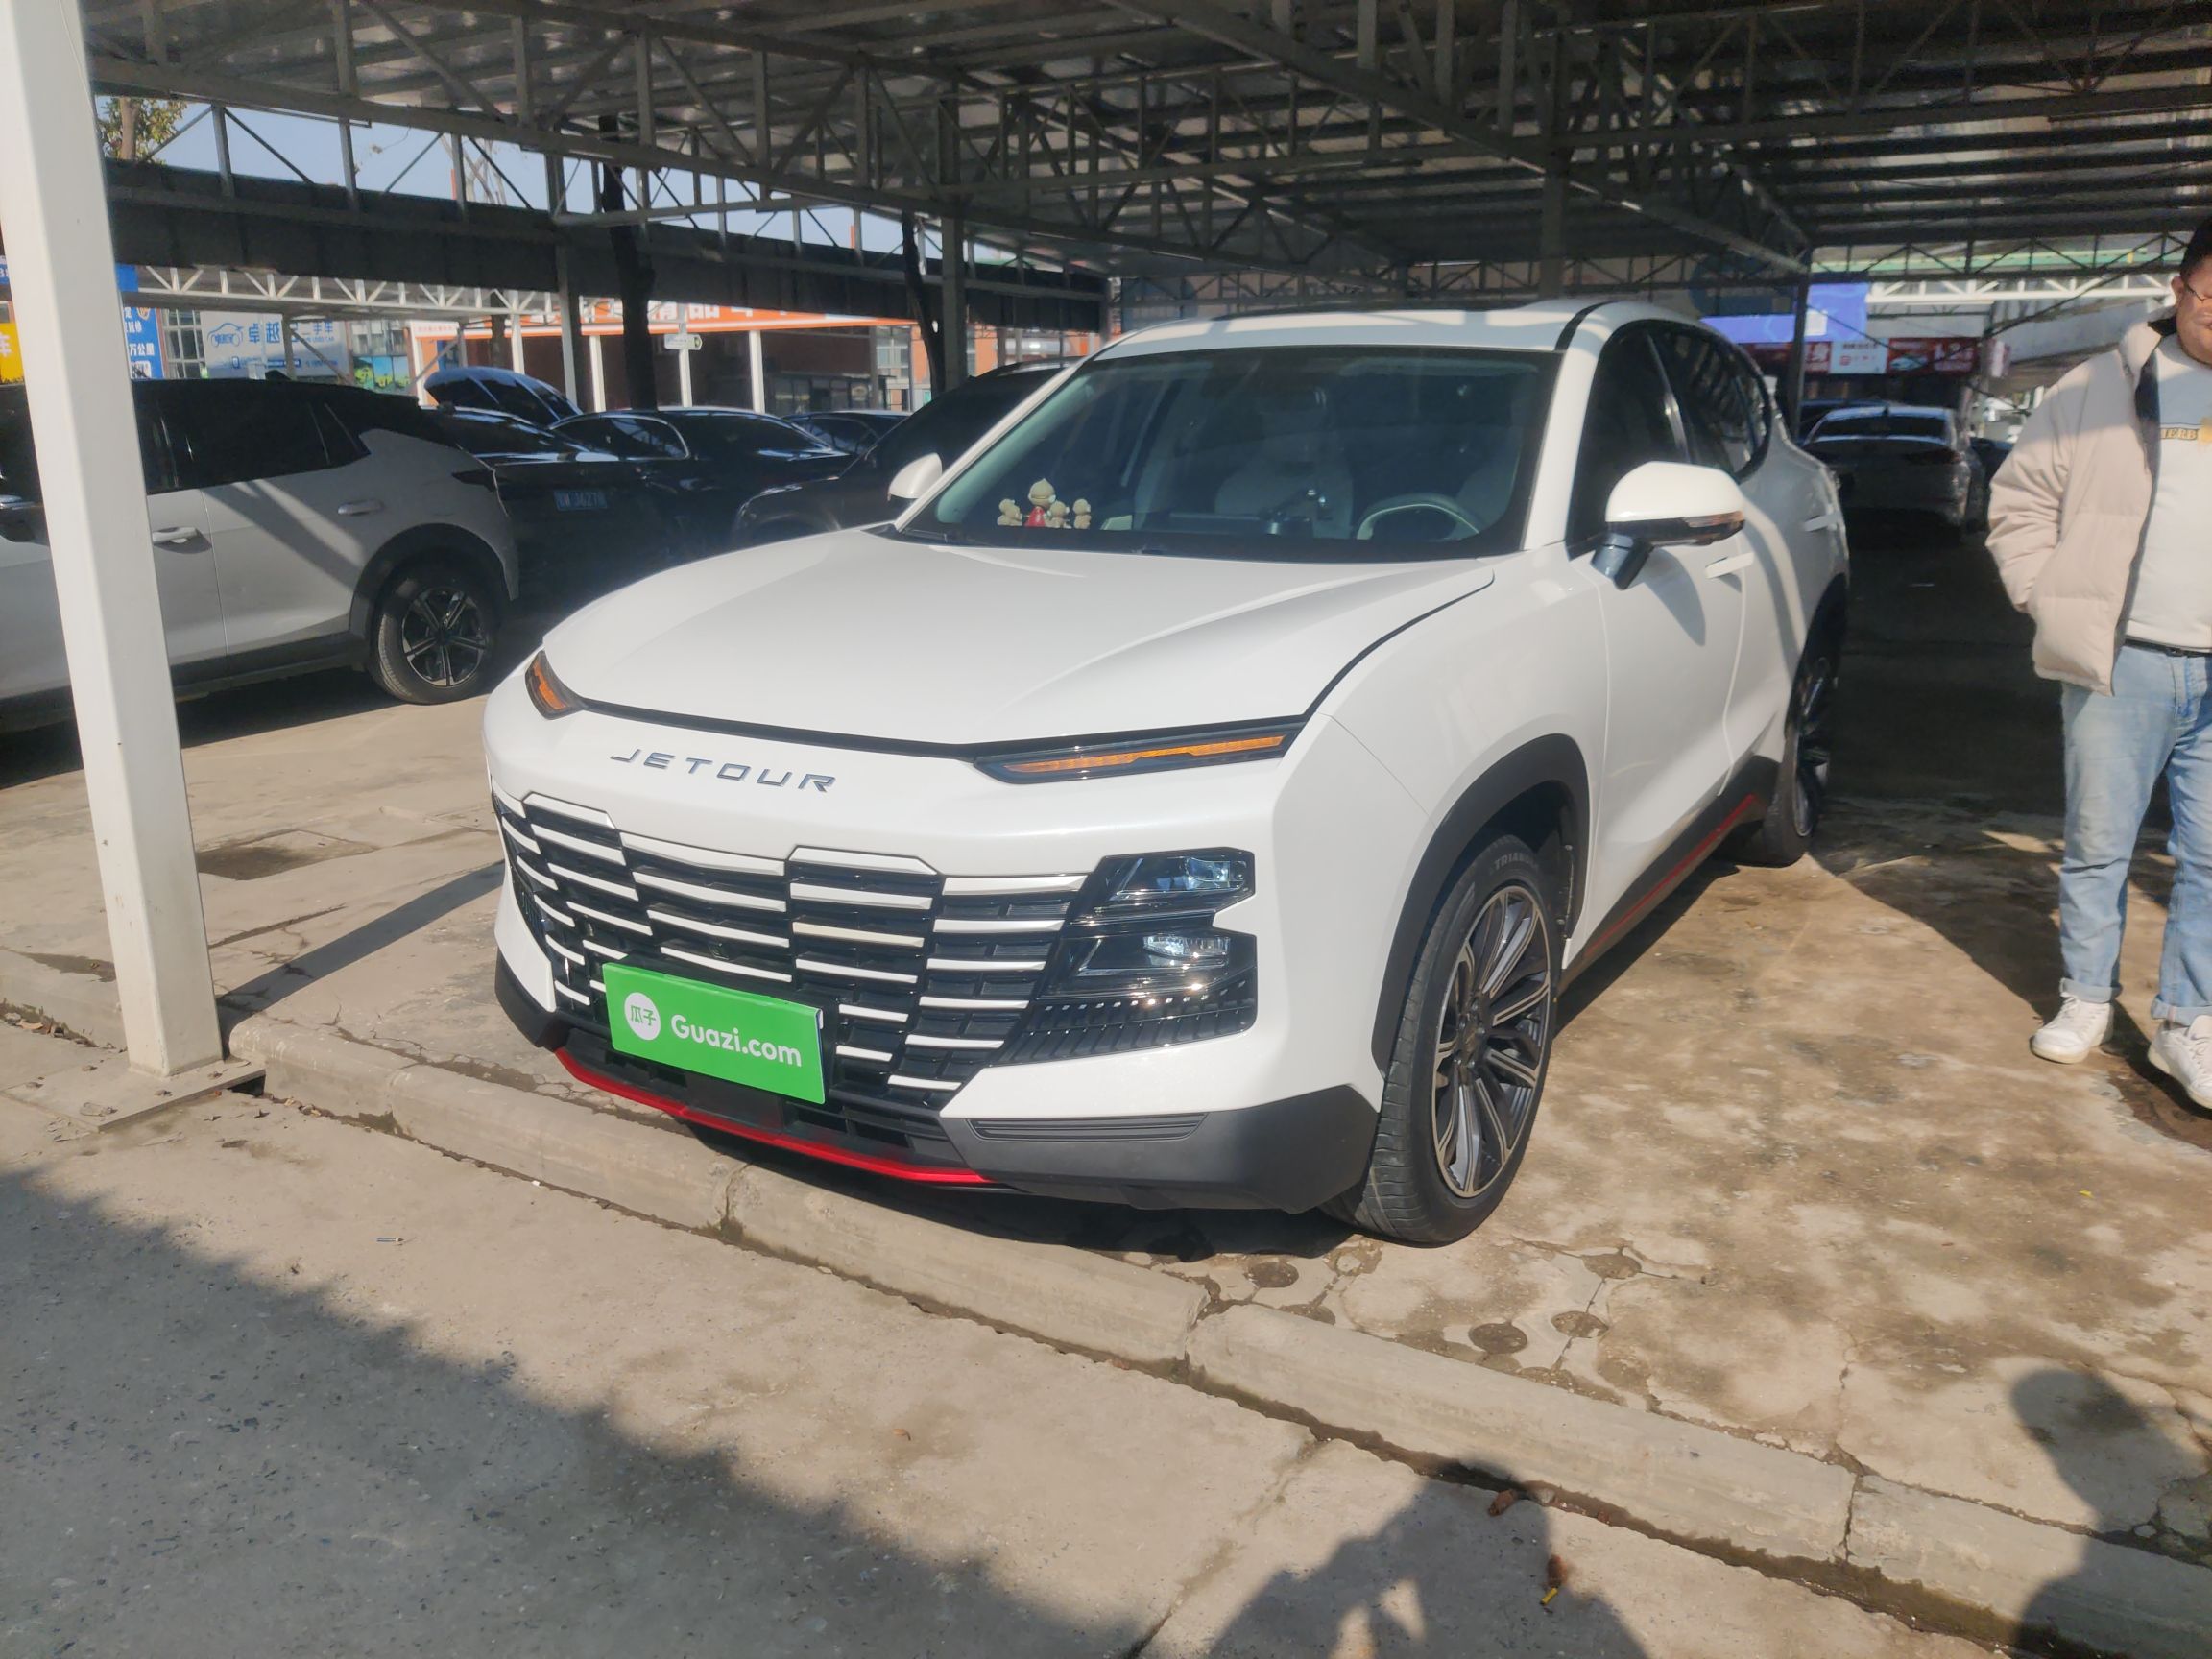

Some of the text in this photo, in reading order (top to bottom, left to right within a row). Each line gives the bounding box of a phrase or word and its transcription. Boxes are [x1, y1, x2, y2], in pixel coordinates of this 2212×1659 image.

[611, 748, 836, 793] JETOUR
[630, 1005, 657, 1027] 瓜子
[670, 1013, 803, 1068] Guazi.com
